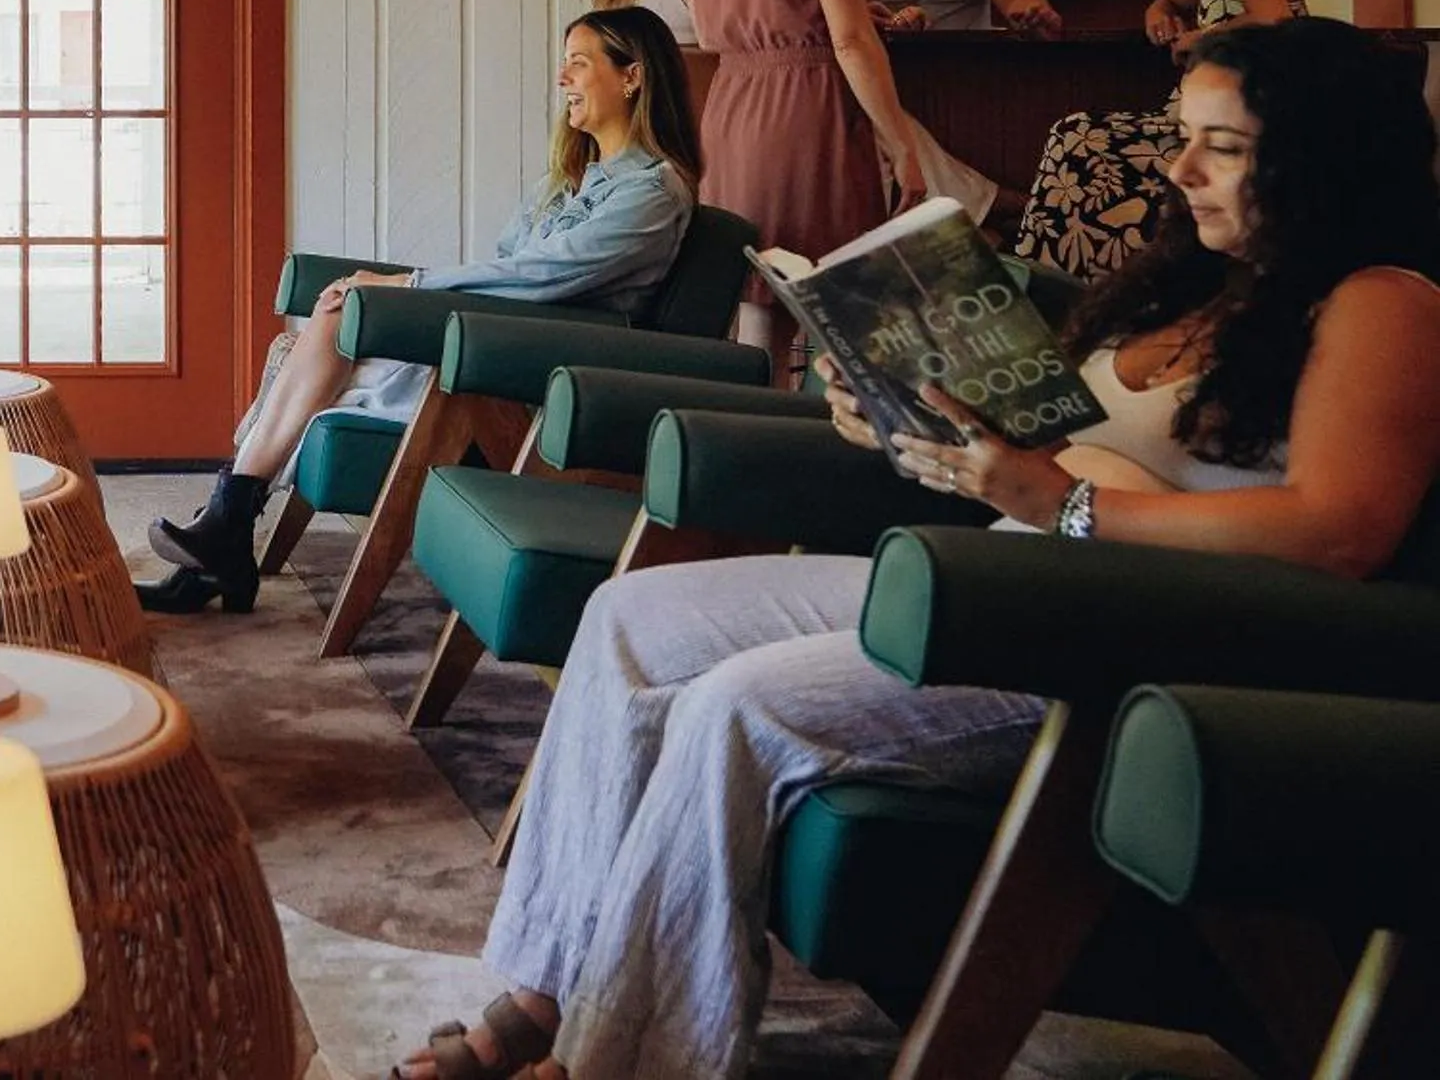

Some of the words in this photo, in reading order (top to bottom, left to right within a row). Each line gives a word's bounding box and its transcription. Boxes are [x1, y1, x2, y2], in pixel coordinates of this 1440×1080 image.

[870, 320, 922, 355] THE
[925, 284, 1012, 334] GOD
[918, 346, 960, 378] OF
[965, 325, 1016, 361] THE
